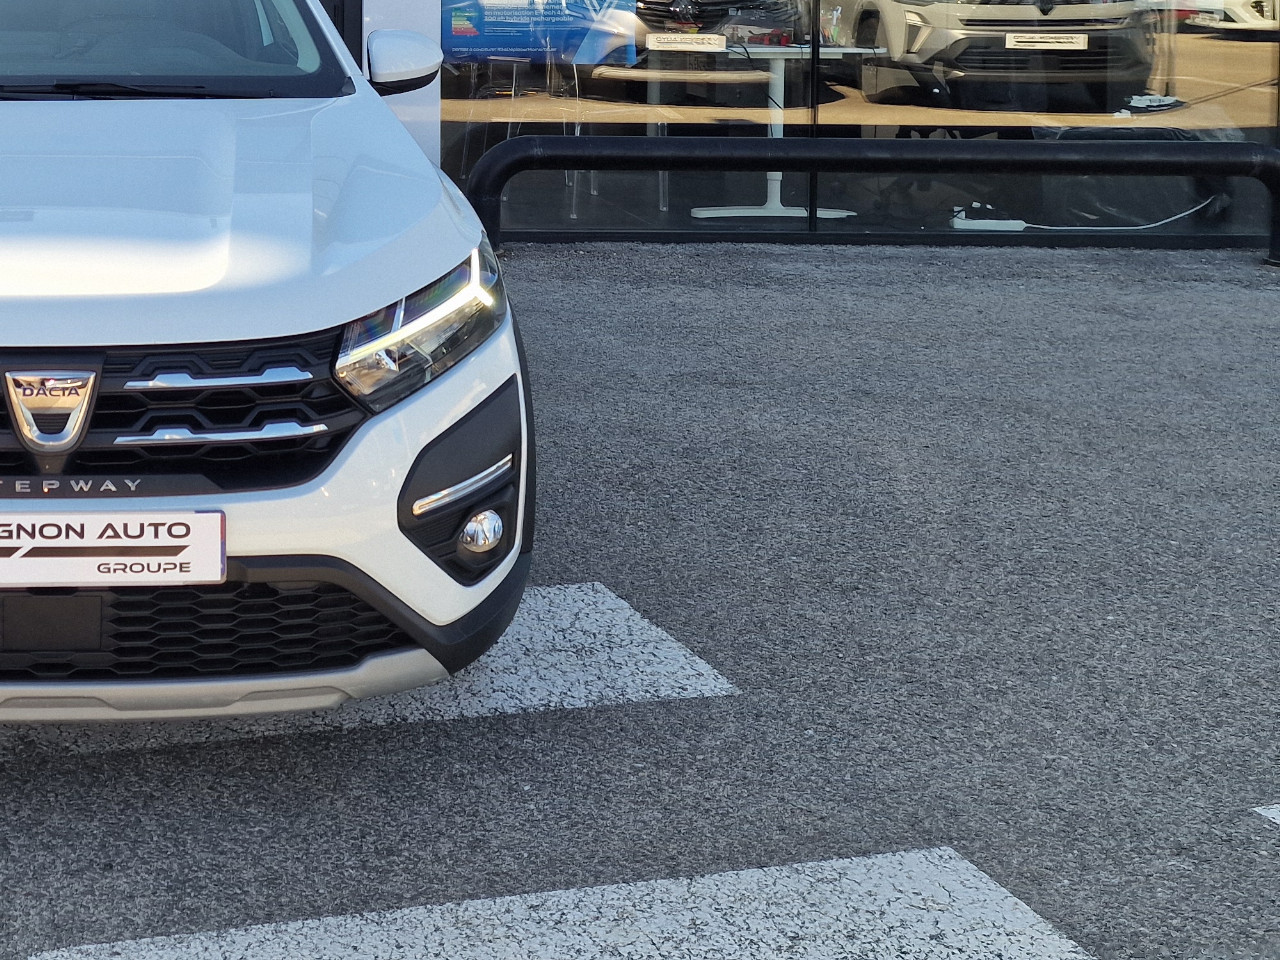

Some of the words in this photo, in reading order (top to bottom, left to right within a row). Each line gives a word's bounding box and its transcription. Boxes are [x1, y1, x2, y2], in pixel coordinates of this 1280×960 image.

[20, 386, 80, 397] DACIA
[96, 522, 191, 540] AUTO
[96, 561, 192, 574] GROUPE
